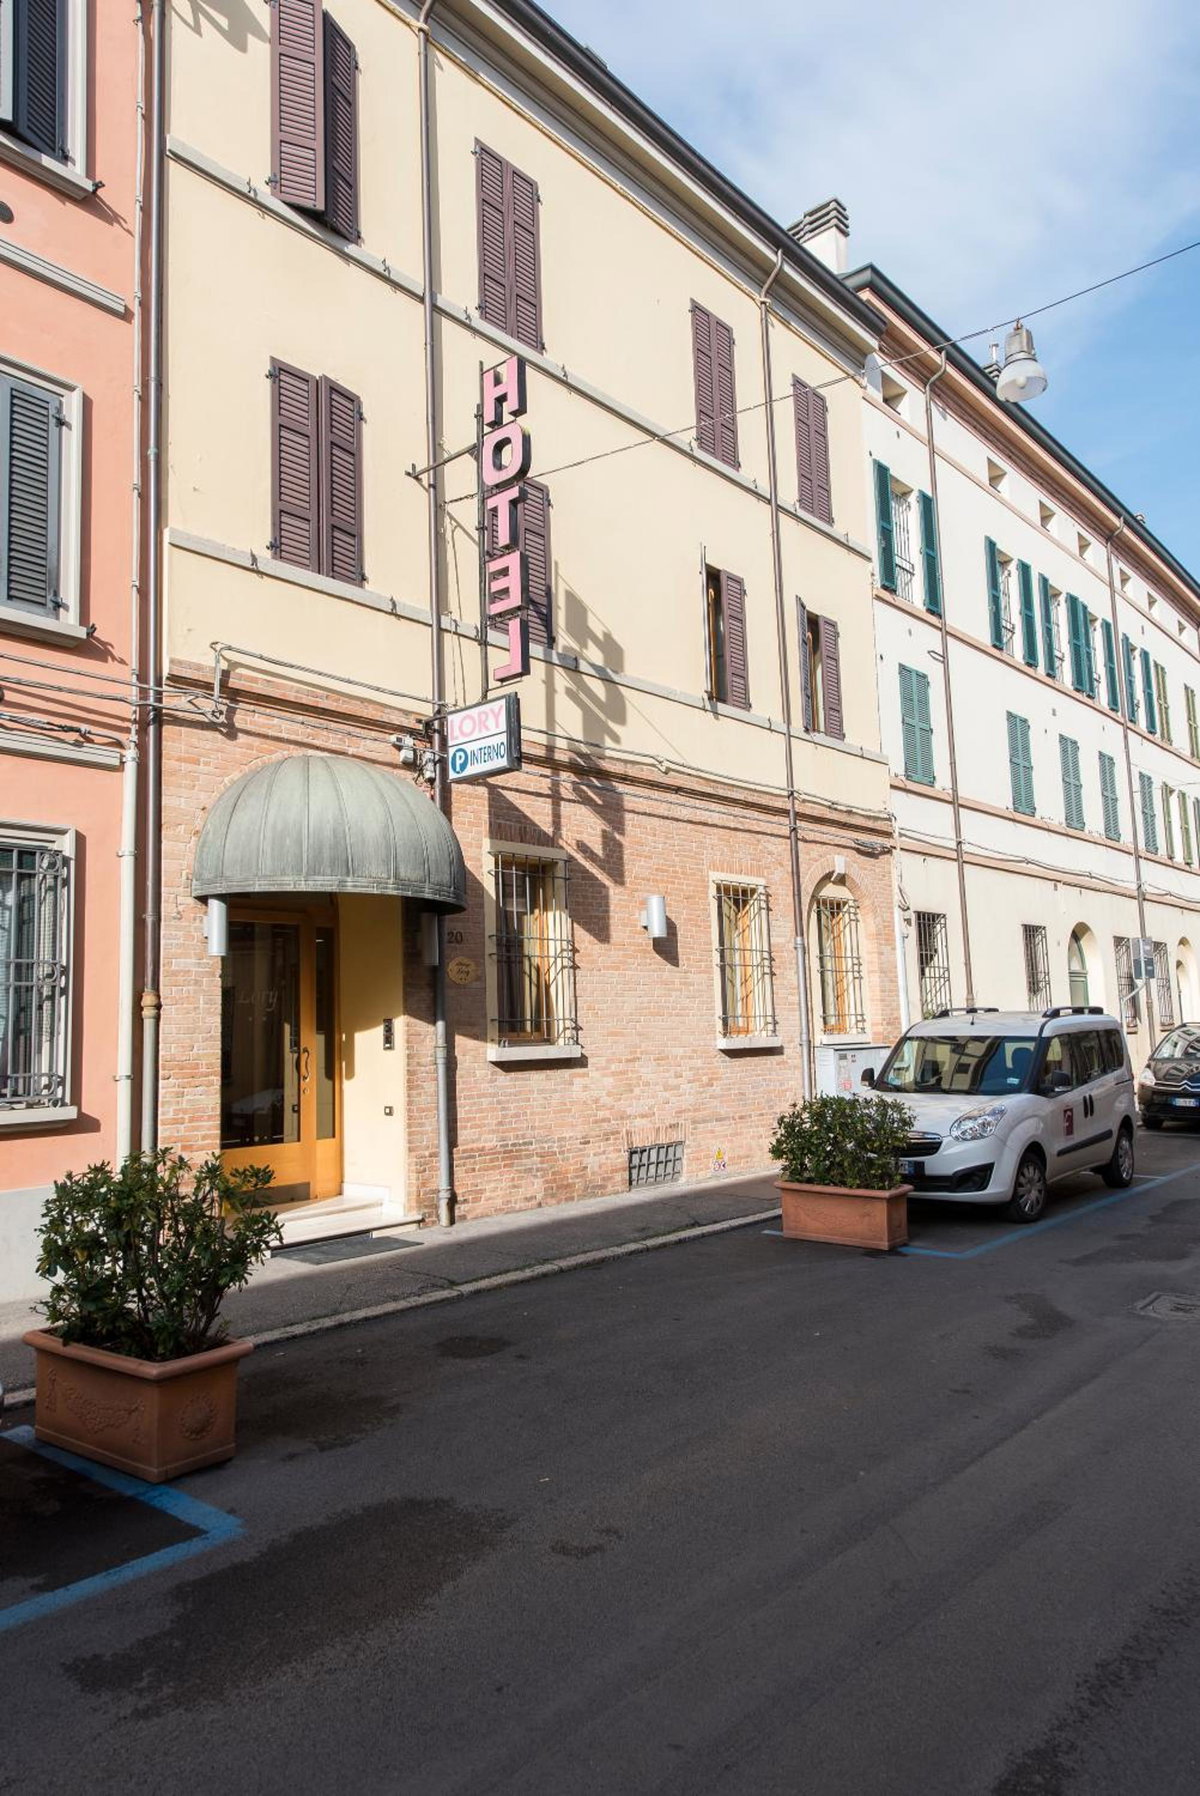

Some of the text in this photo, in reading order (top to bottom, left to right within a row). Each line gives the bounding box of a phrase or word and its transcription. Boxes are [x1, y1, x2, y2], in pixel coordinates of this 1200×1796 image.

[449, 705, 504, 741] LORY
[454, 742, 505, 773] P INTERNO
[447, 931, 463, 945] 20
